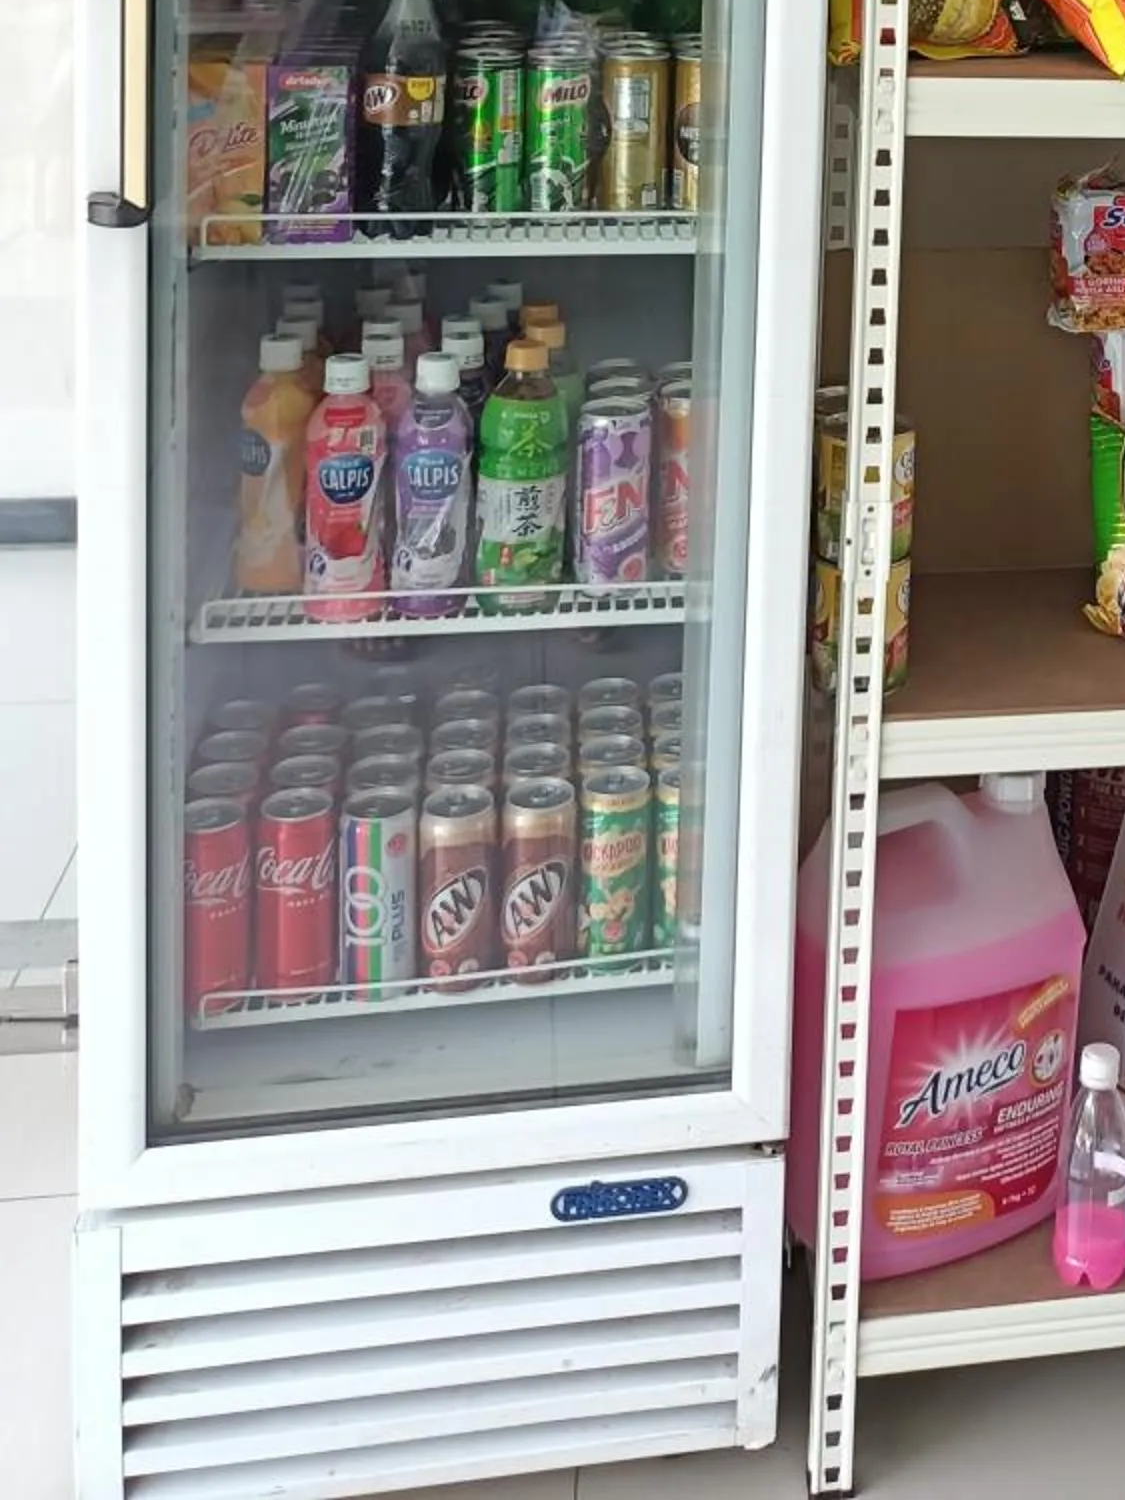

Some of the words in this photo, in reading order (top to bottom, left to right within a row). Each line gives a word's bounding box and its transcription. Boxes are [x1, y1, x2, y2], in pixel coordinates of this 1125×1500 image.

[541, 78, 591, 102] MILO
[320, 466, 373, 493] CALPIS
[896, 1040, 1025, 1127] Ameco
[998, 1081, 1064, 1124] ENDURING
